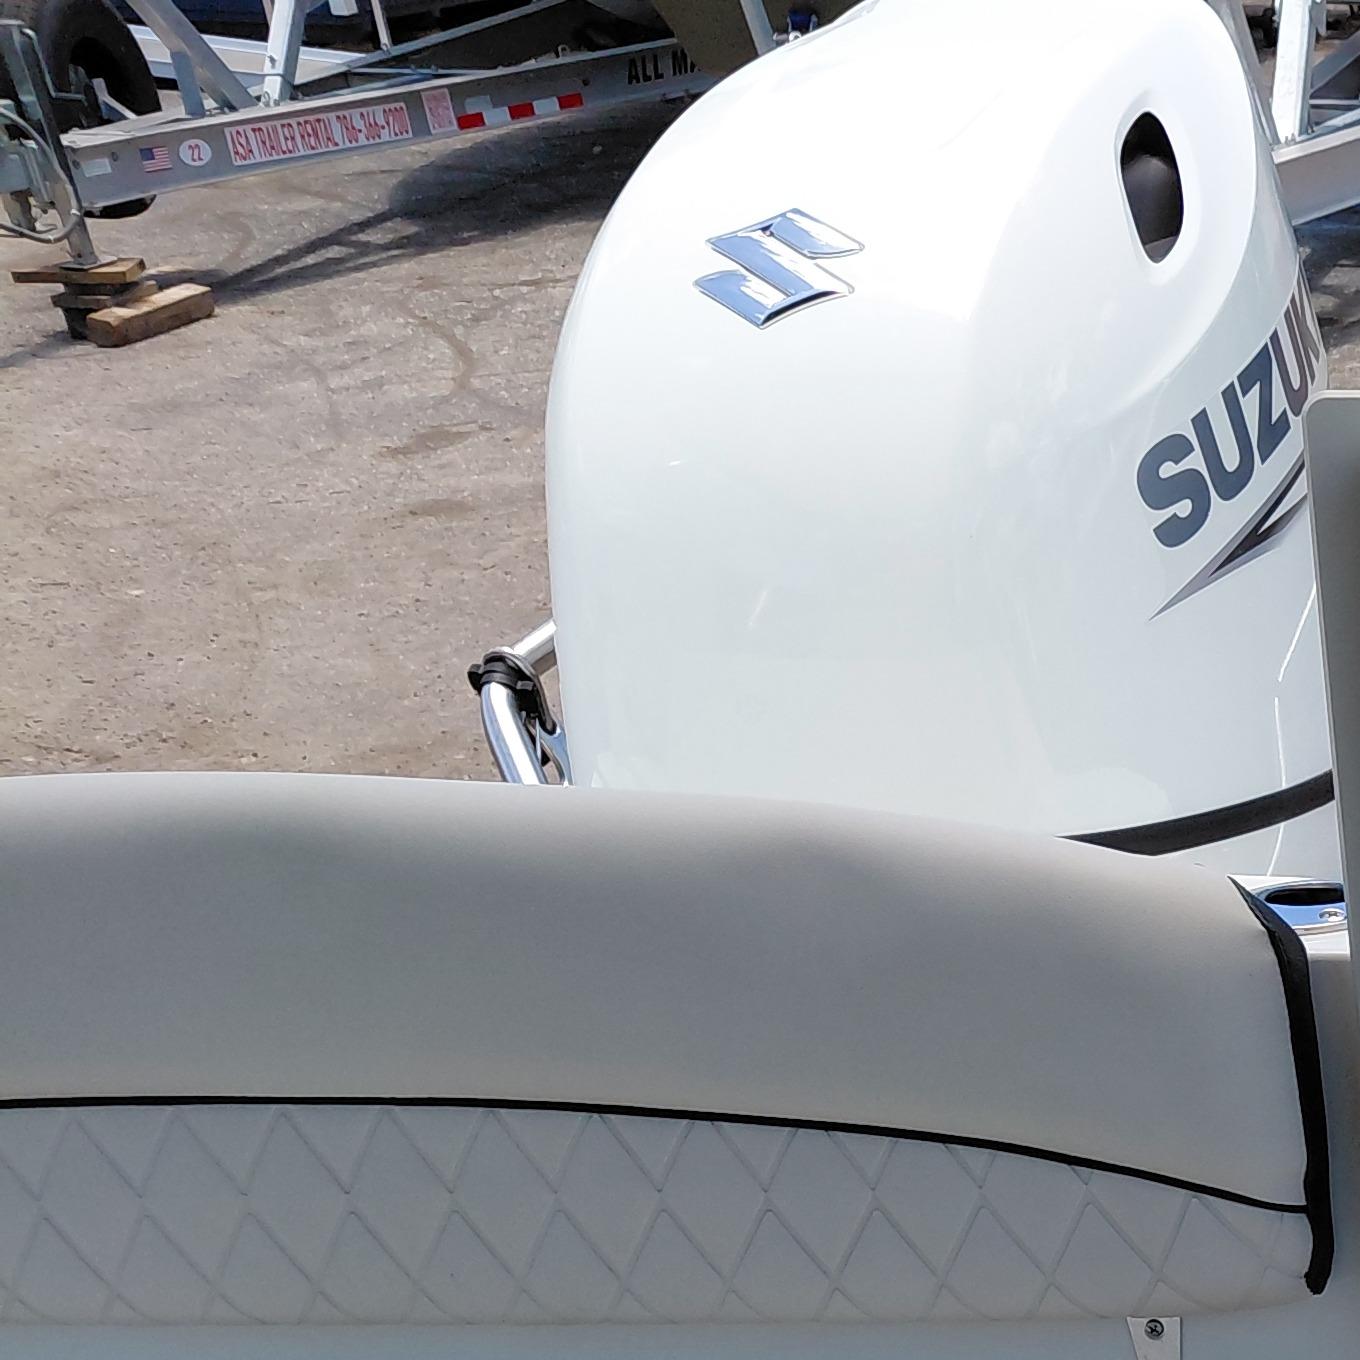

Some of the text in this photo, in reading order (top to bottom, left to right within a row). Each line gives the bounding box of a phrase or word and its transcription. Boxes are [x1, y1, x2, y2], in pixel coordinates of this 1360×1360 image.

[627, 53, 664, 85] ALL
[188, 144, 204, 162] 22
[230, 128, 256, 162] ASA
[251, 122, 300, 160] TRAILER
[297, 117, 339, 152] RENTAL
[1137, 265, 1322, 548] SUZUK
